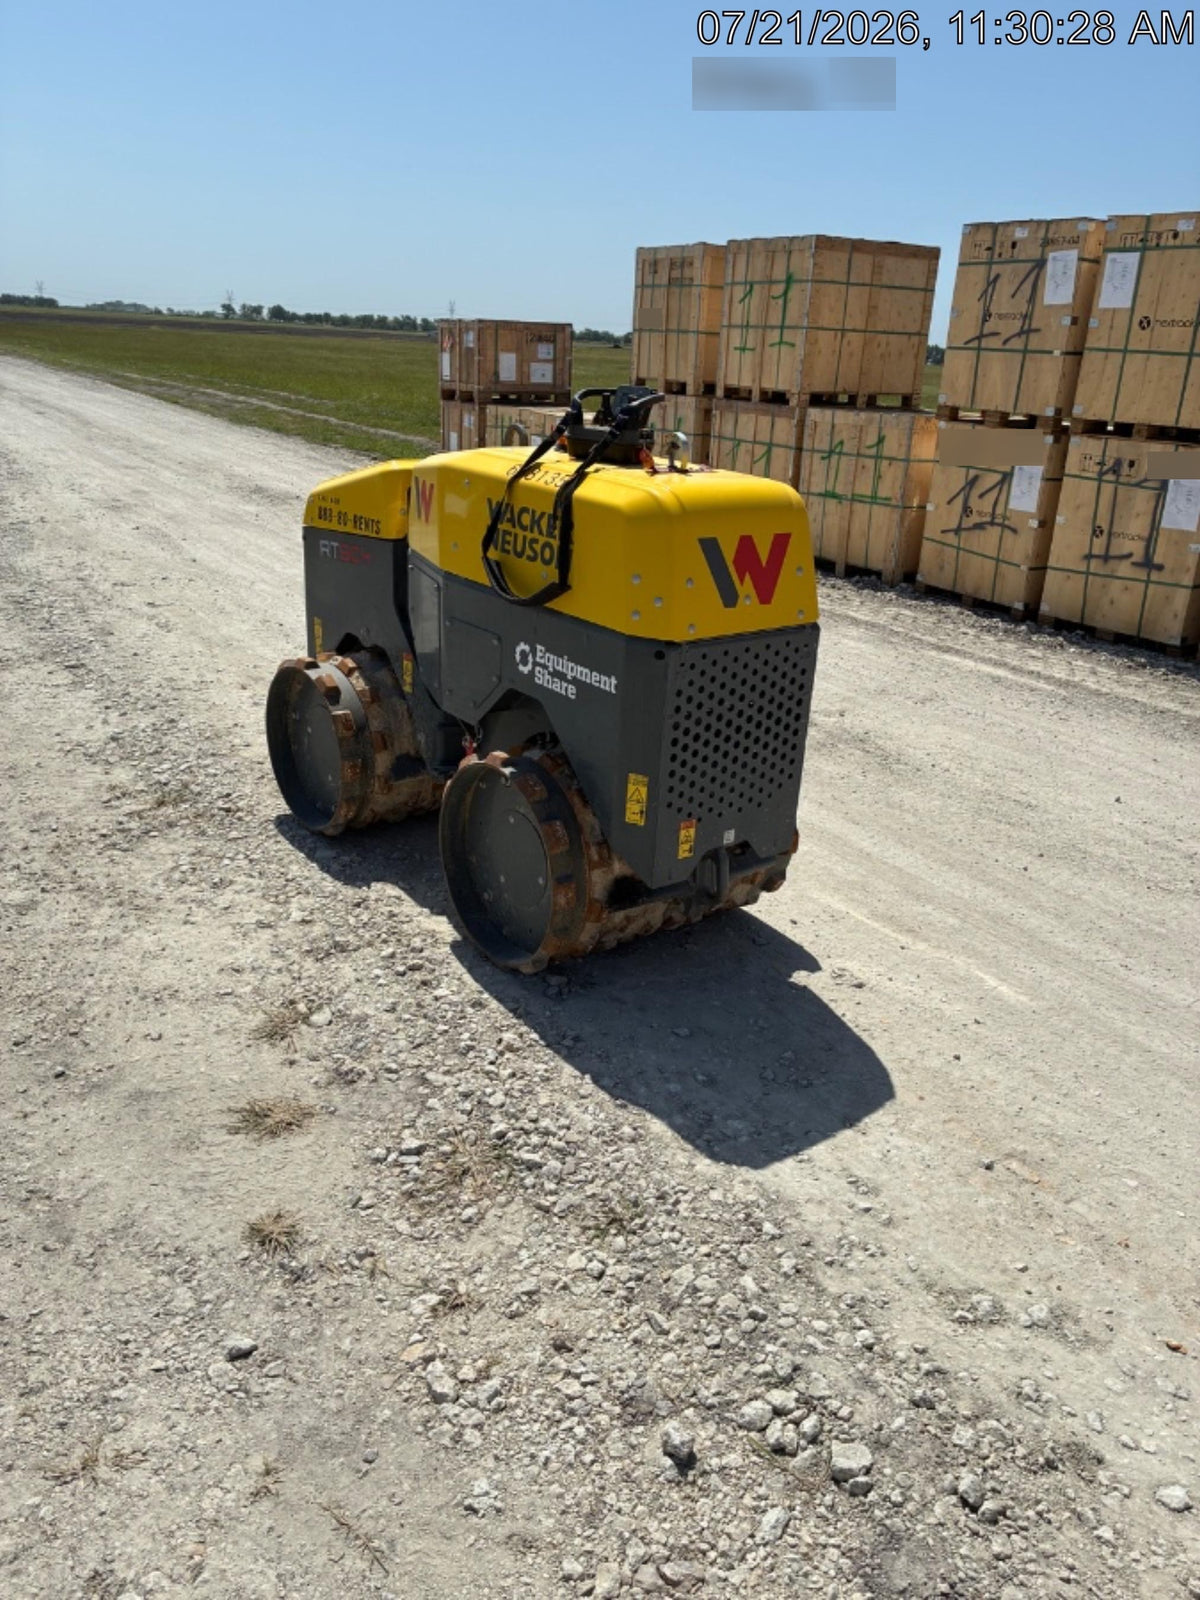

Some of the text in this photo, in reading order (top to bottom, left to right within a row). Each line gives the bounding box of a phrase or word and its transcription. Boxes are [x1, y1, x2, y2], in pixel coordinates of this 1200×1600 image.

[697, 532, 792, 609] W
[534, 665, 577, 700] Share
[535, 643, 618, 694] Equipment
